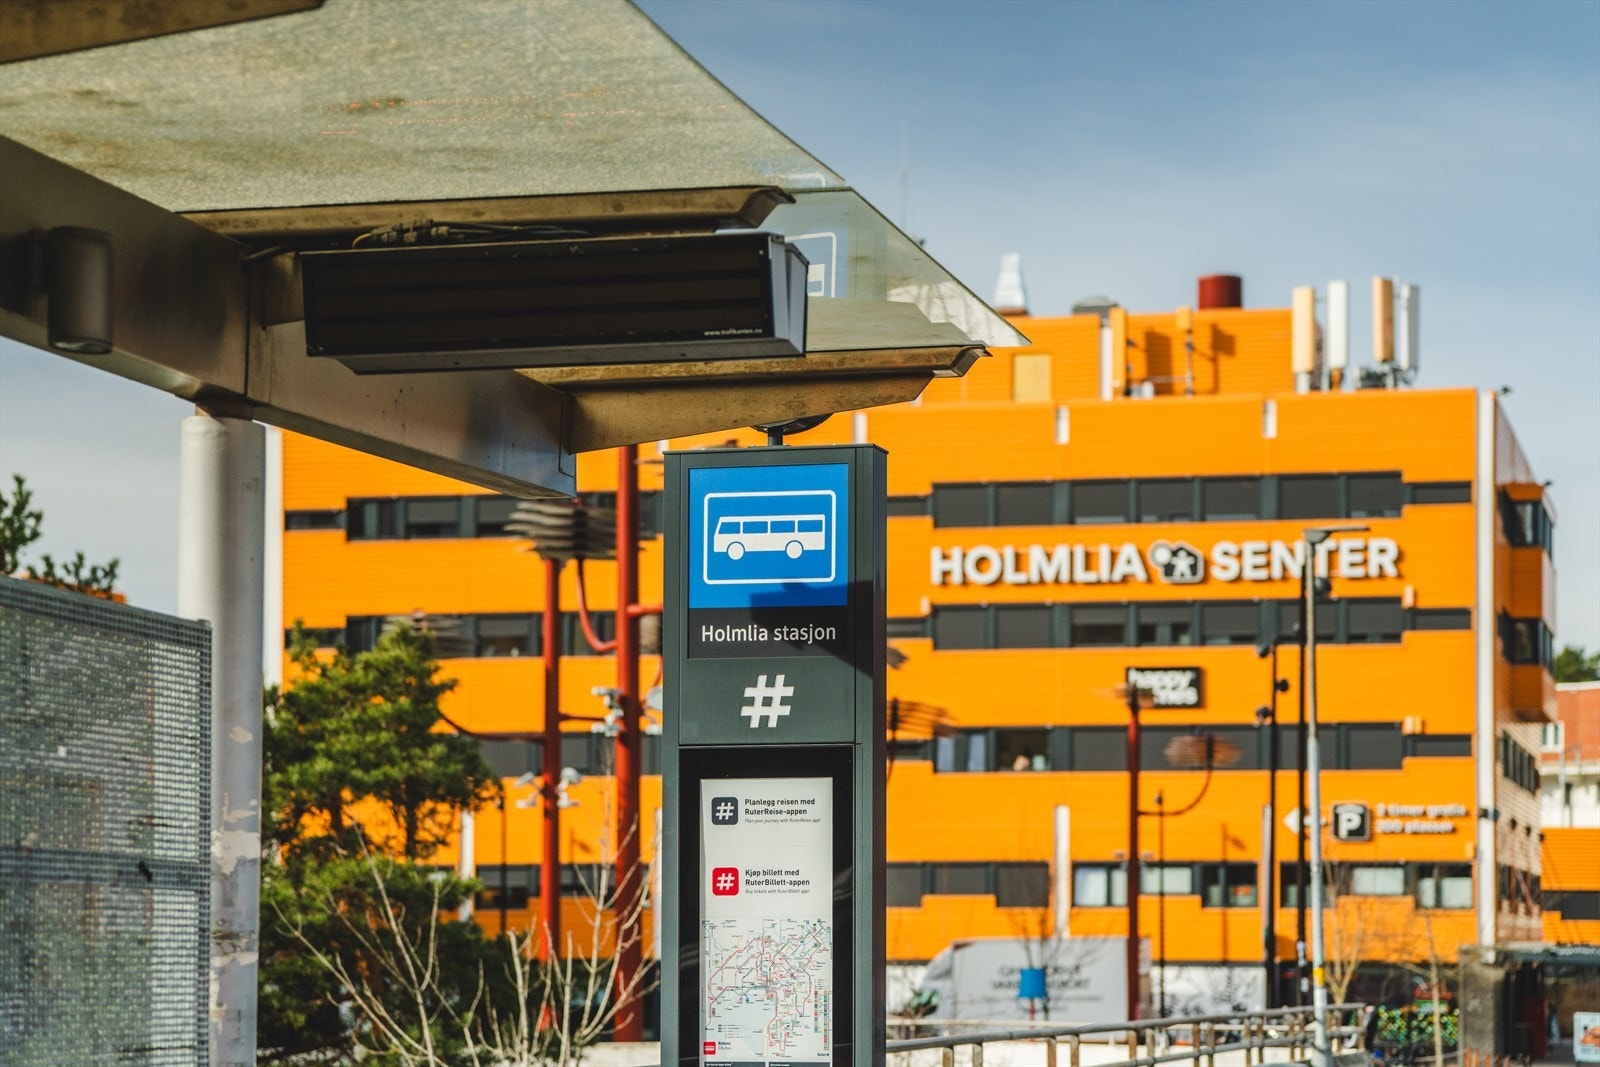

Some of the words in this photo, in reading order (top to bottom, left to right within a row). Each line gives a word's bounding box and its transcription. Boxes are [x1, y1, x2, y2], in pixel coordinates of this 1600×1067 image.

[930, 543, 1147, 586] HOLMLIA
[1211, 537, 1399, 580] SENTER
[701, 624, 768, 642] Holmlia
[774, 624, 836, 644] stasjon
[744, 798, 776, 807] Planlegg
[776, 798, 799, 806] reisen
[744, 807, 808, 816] RuterReise-appen
[745, 869, 761, 878] Kjøp
[745, 878, 810, 887] RuterBillett-appen
